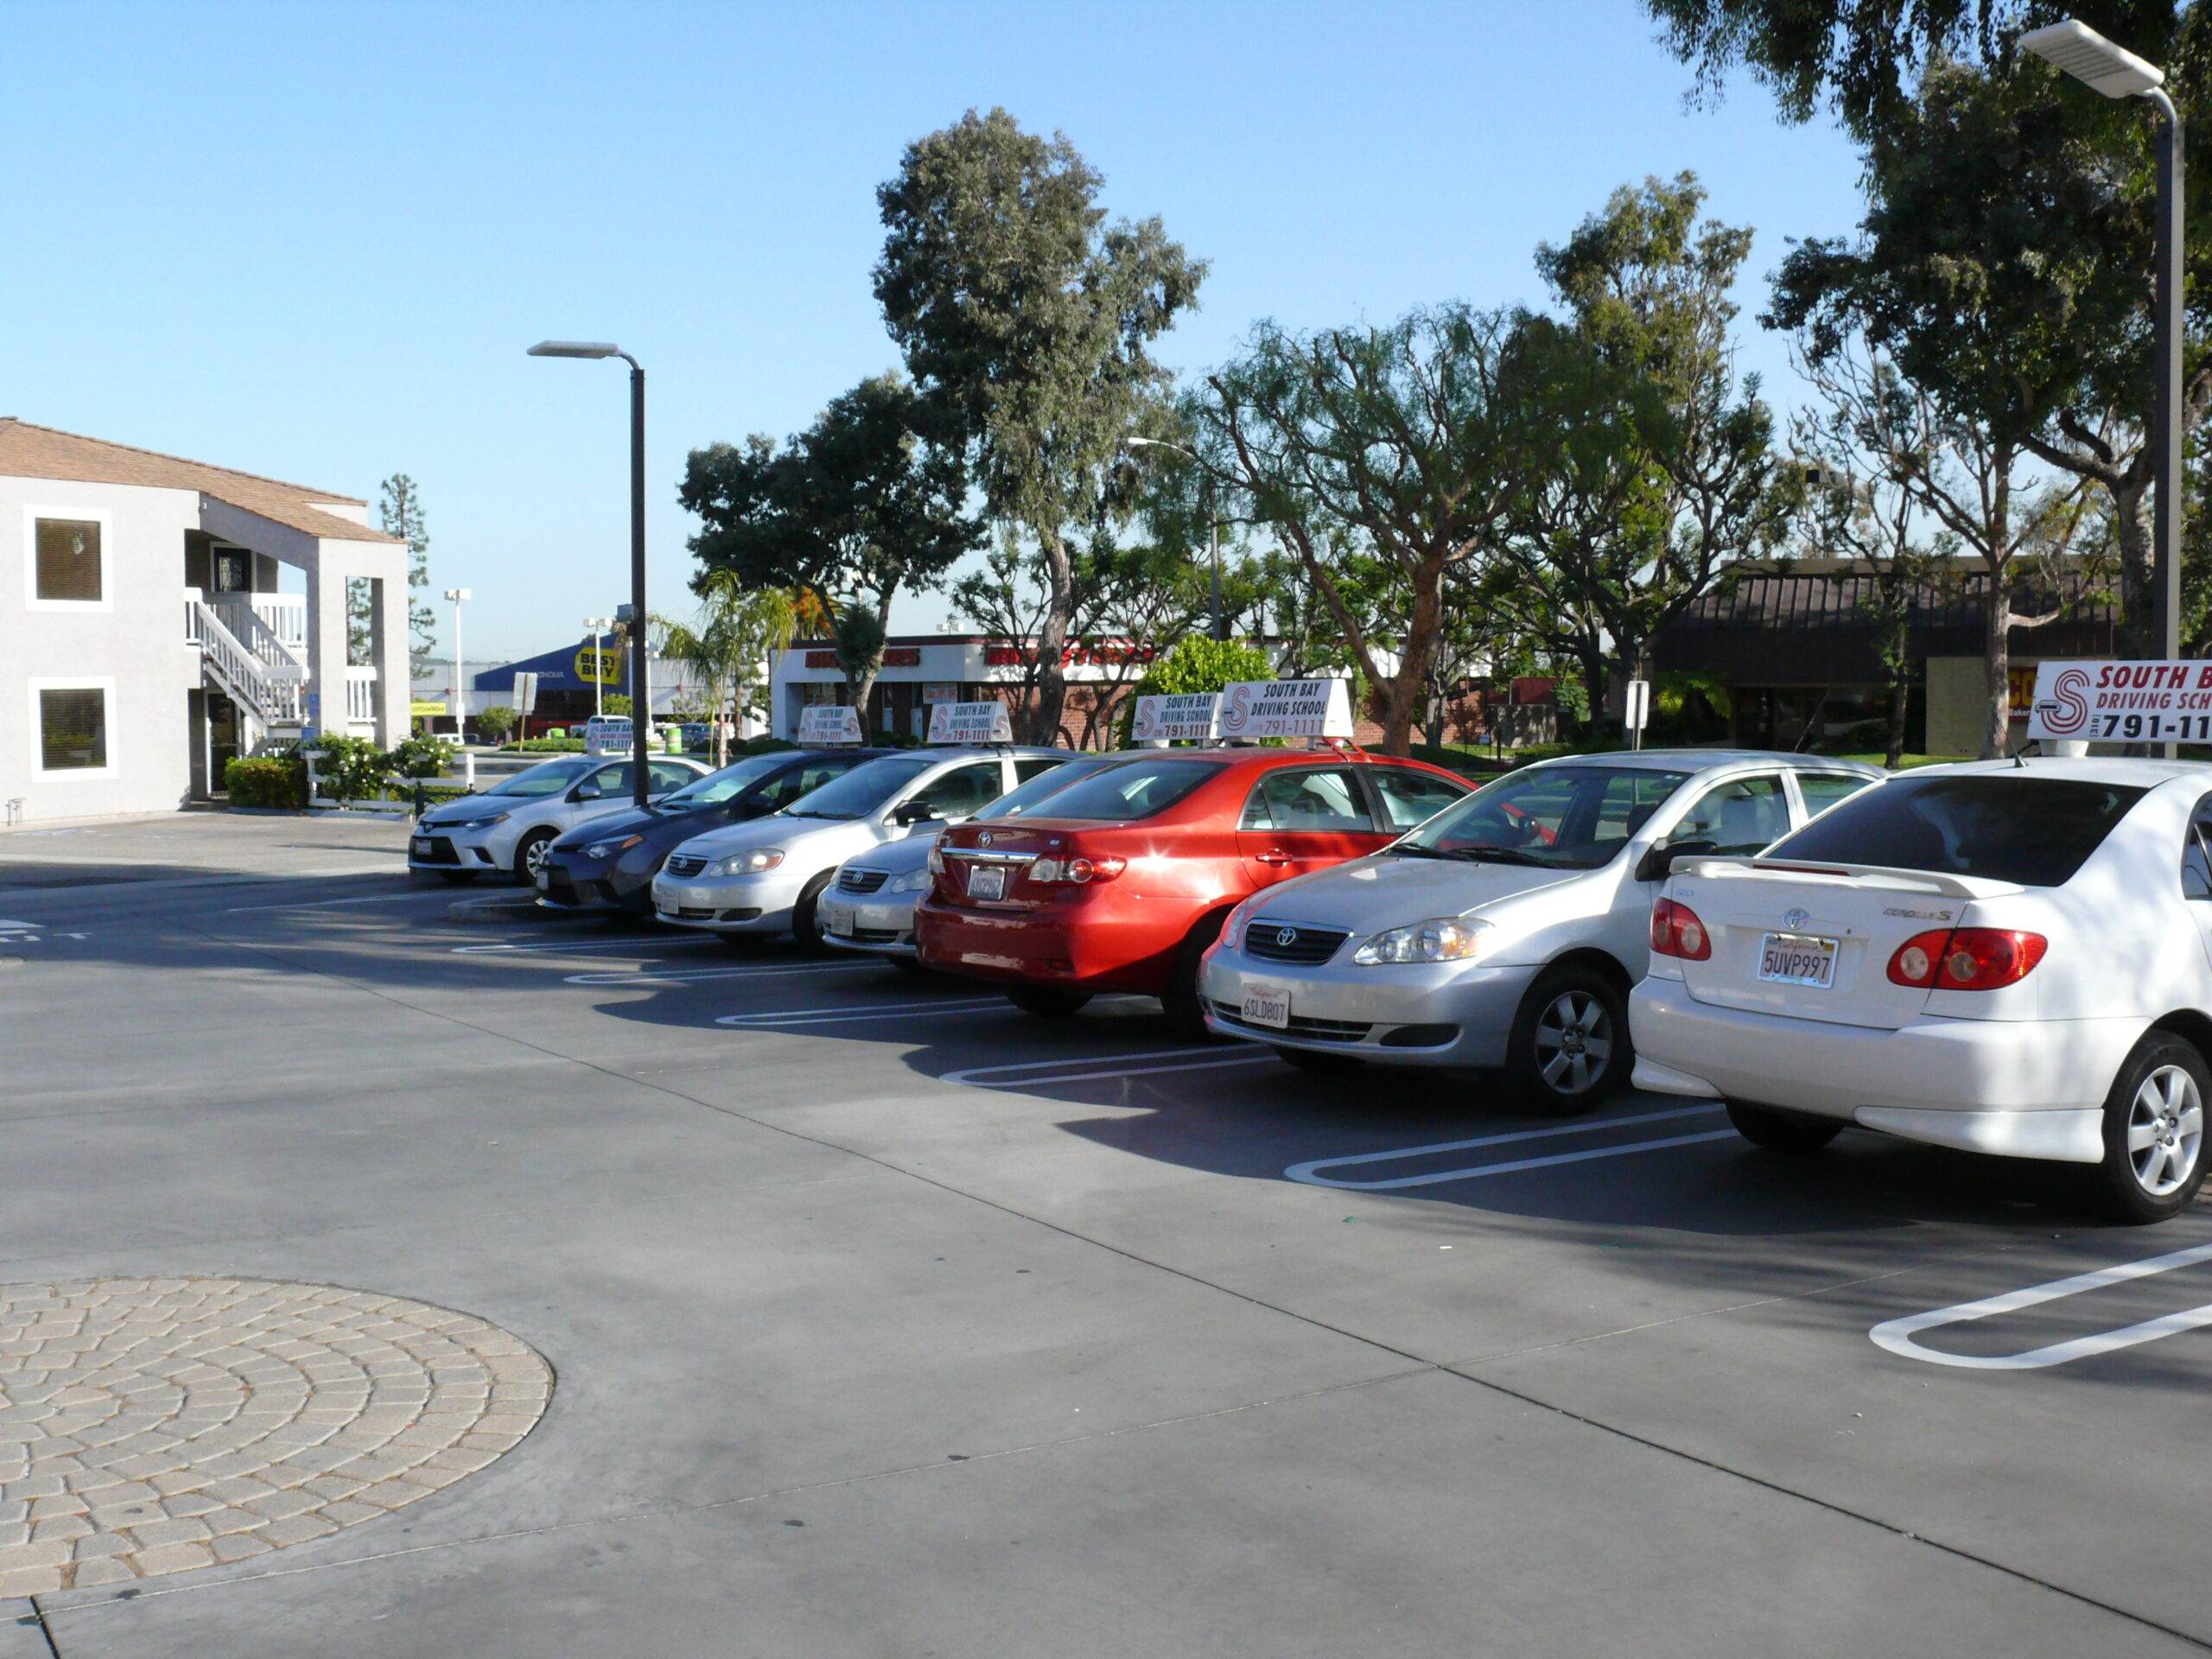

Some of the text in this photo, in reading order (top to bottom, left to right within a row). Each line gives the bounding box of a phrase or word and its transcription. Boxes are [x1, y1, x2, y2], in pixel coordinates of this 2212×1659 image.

[2095, 665, 2189, 690] SOUTH
[1263, 682, 1321, 698] SOUTH BAY
[1166, 695, 1211, 709] SOUTH BAY
[1251, 700, 1325, 716] DRIVING SCHOOL
[2096, 693, 2171, 709] DRIVING
[954, 704, 991, 717] SOUTH BAY
[1160, 709, 1211, 723] DRIVING SCHOOL
[600, 724, 620, 733] SOUTH
[950, 717, 991, 729] DRIVING SCHOOL
[1265, 719, 1323, 734] 791-1111
[953, 729, 990, 741] 791-1111
[1165, 724, 1210, 737] 791-1111
[1764, 950, 1830, 979] 5UVP997
